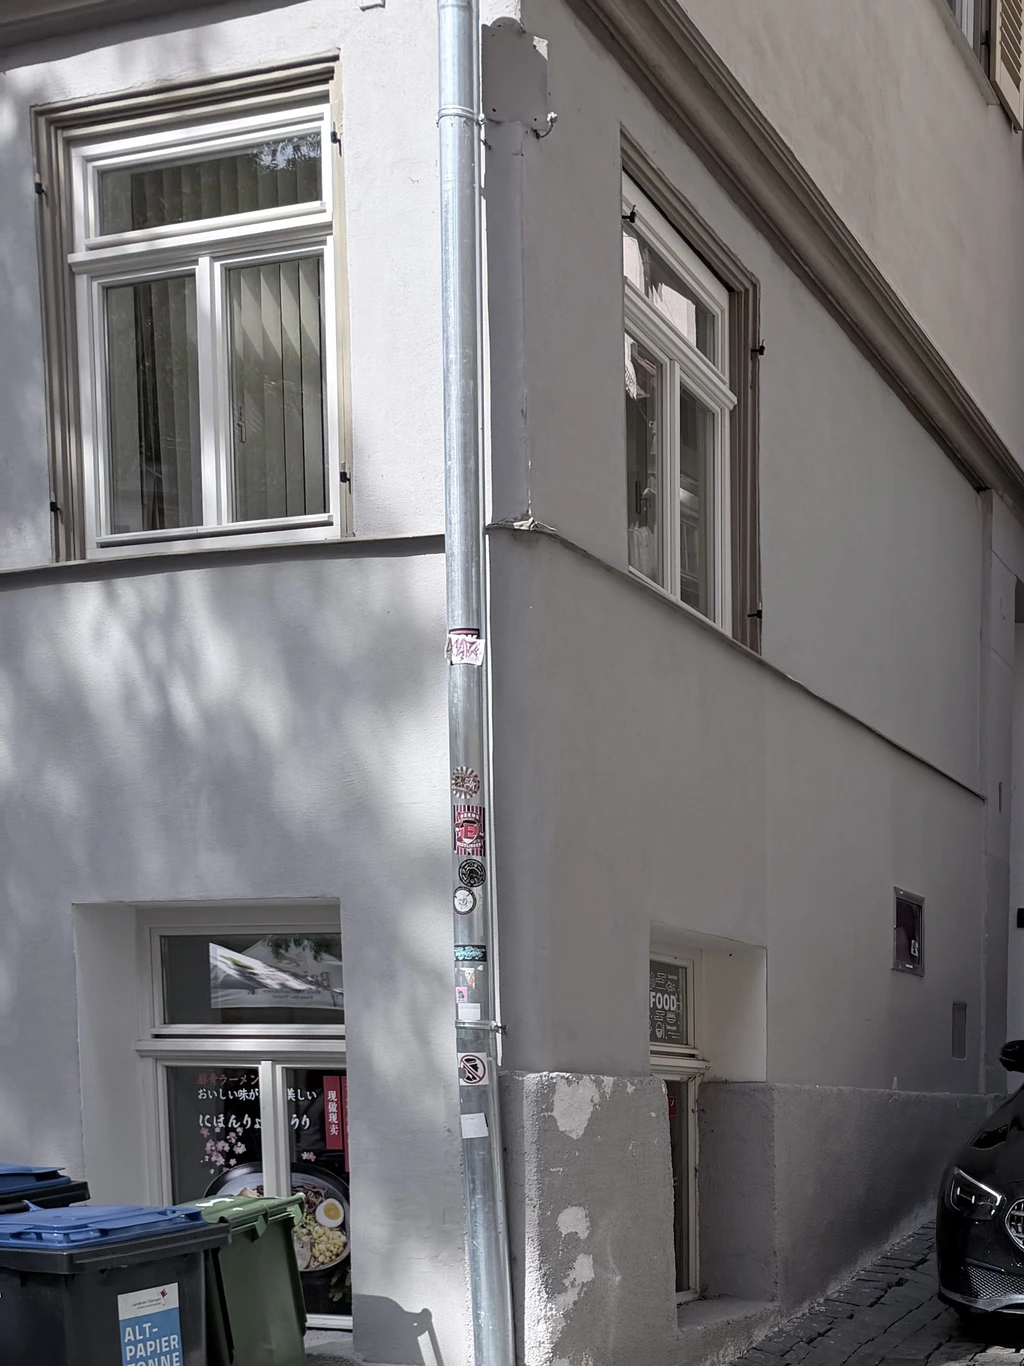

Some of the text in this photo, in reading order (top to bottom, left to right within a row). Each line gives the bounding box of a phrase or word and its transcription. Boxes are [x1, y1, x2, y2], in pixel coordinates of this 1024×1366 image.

[650, 991, 677, 1011] FOOD
[124, 1322, 159, 1343] ALT-
[125, 1334, 179, 1361] PAPIER
